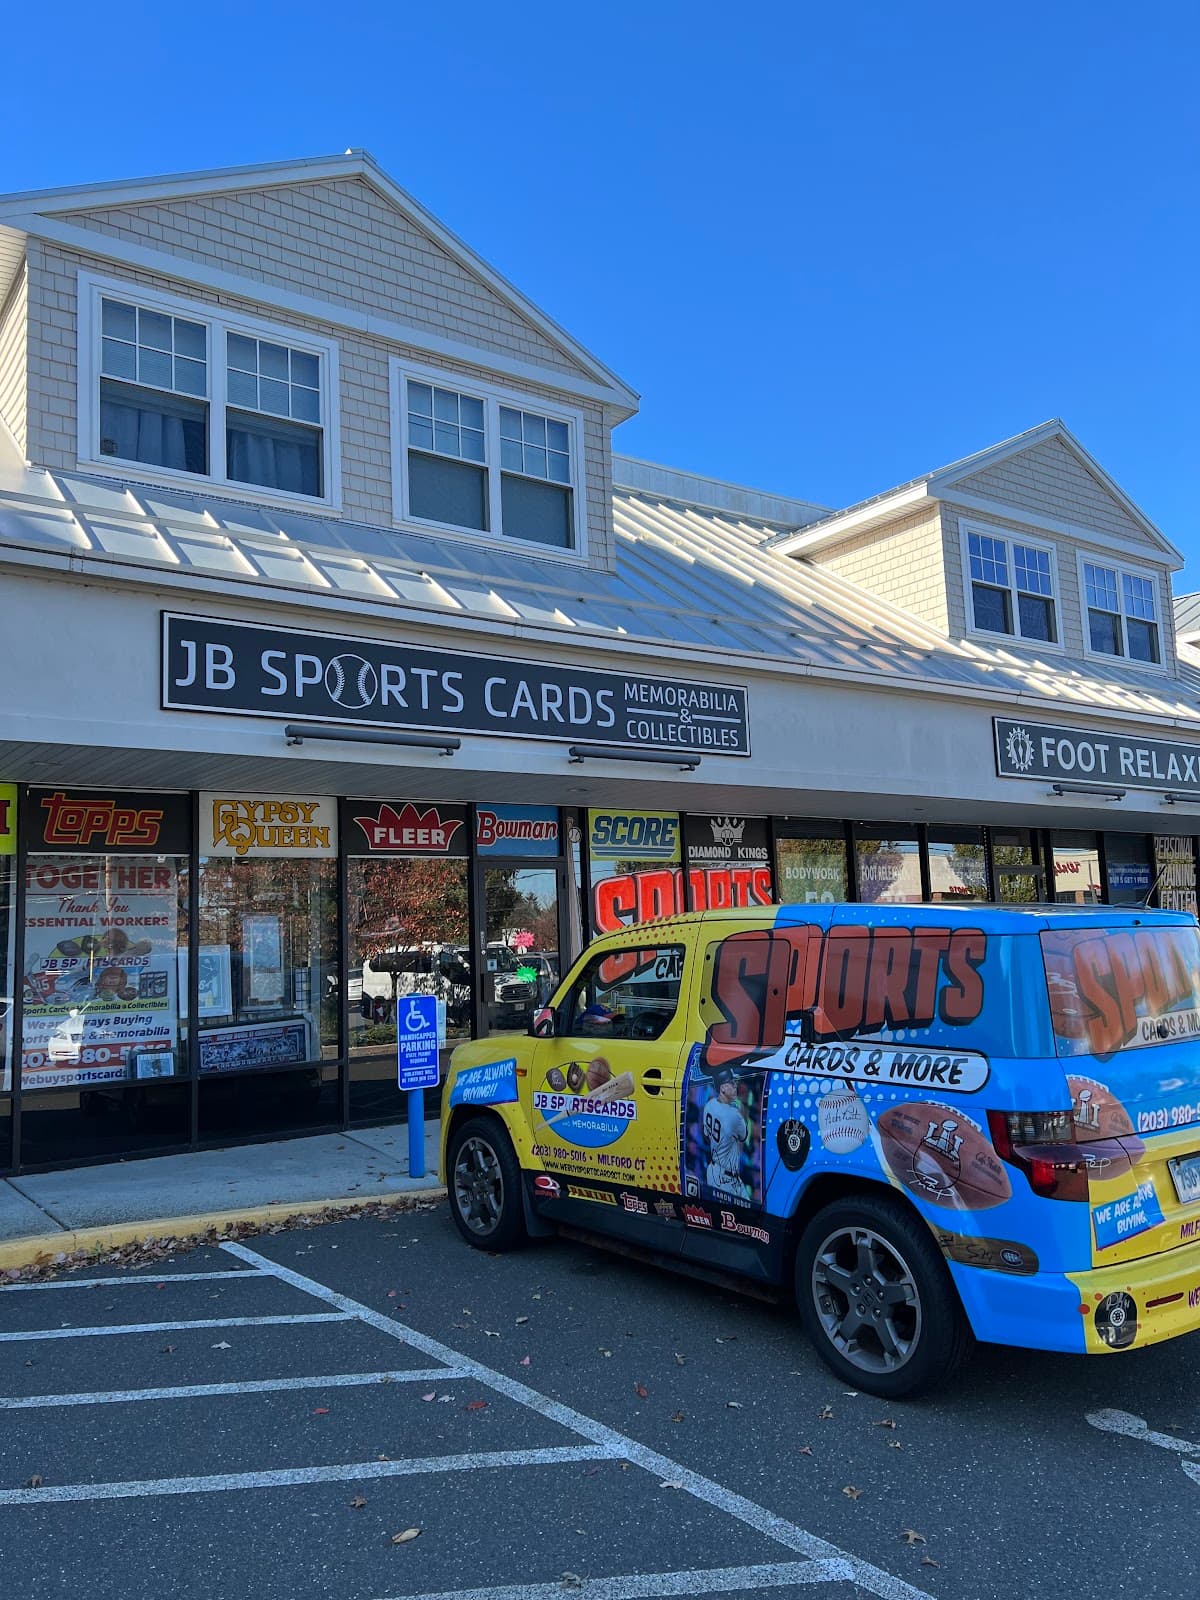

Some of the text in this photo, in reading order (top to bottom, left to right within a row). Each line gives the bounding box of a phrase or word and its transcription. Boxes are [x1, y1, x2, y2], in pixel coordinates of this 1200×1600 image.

[175, 639, 237, 690] JB
[484, 676, 616, 728] CARDS
[624, 682, 739, 713] MEMORABILIA
[679, 708, 693, 723] &
[626, 719, 739, 748] COLLECTIBLES
[1041, 736, 1200, 783] FOOT RELAX
[212, 799, 321, 848] GYPSY
[225, 816, 331, 855] QUEEN
[476, 810, 559, 847] Bowman
[591, 815, 679, 847] SCORE
[374, 827, 446, 846] FLEER
[1154, 836, 1196, 861] PERSONAL
[688, 845, 768, 860] DIAMOND KINGS
[25, 863, 172, 890] TOGETHER
[785, 866, 841, 882] BODYWORK
[57, 896, 131, 913] Thank You
[25, 916, 169, 928] ESSENTIAL WORKERS
[41, 958, 58, 969] JB
[127, 1001, 168, 1010] Collectibles
[705, 925, 987, 1066] SPORTS
[113, 1014, 153, 1026] Buying
[401, 1039, 436, 1053] PARKING
[482, 1061, 514, 1082] ALWAYS
[785, 1042, 969, 1085] CARDS & MORE
[534, 1093, 549, 1109] JB
[572, 1119, 619, 1133] MEMORABILIA
[704, 1112, 722, 1144] 99
[1137, 1107, 1168, 1133] (203)
[531, 1143, 646, 1171] (203) 980-5016 MILFORD CT
[569, 1185, 614, 1204] PANINI
[687, 1214, 711, 1227] FLEER
[1096, 1206, 1112, 1225] WE
[1114, 1198, 1131, 1218] ARE
